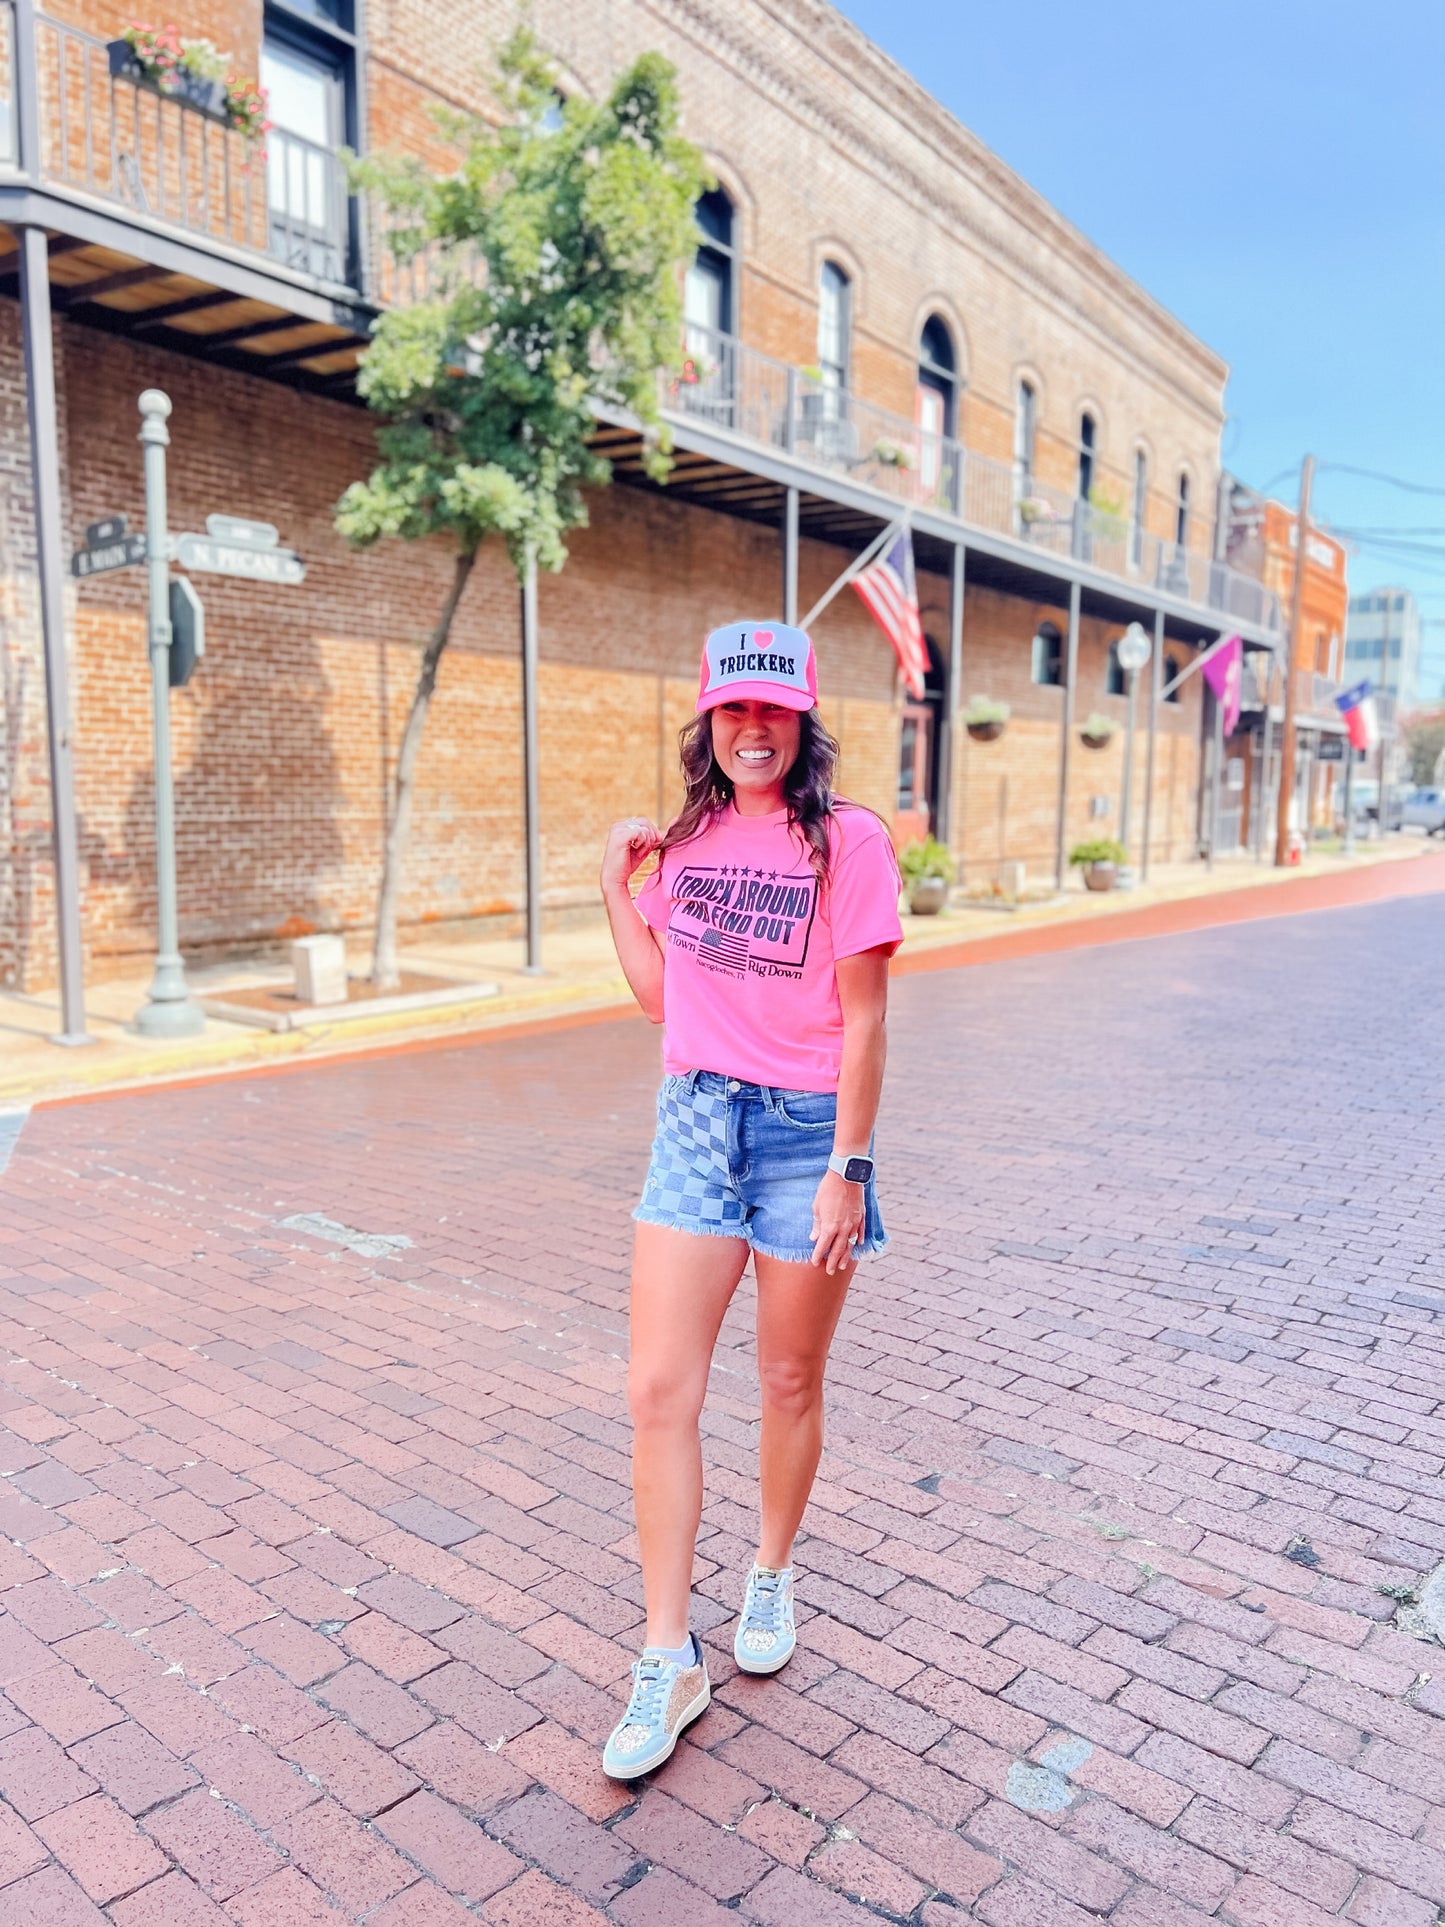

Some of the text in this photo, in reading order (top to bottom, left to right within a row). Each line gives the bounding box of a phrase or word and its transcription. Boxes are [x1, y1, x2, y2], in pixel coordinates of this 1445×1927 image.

[740, 633, 746, 650] I
[719, 653, 795, 676] TRUCKERS
[677, 875, 810, 919] TRUCK AROUND
[711, 905, 753, 935] FIND
[753, 916, 795, 944] OUT
[673, 933, 697, 953] Town
[748, 960, 803, 980] Rig Down
